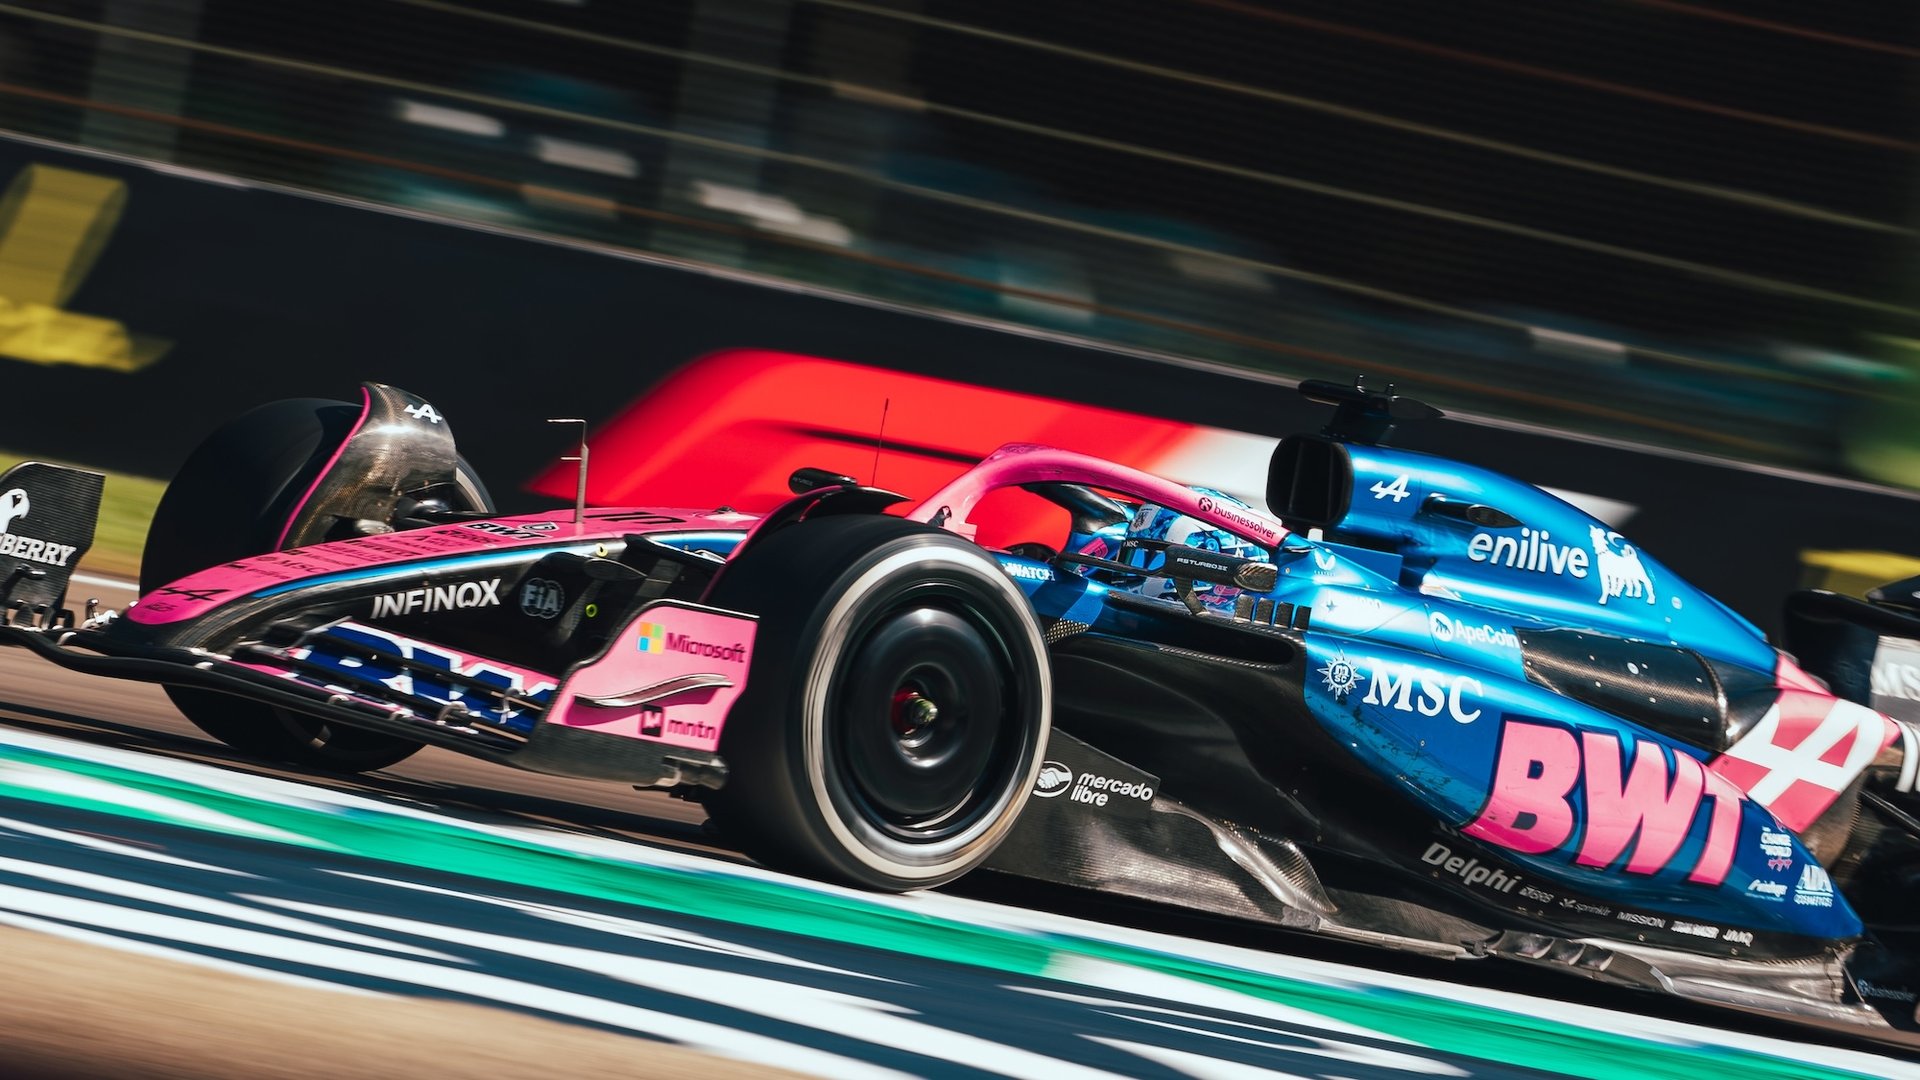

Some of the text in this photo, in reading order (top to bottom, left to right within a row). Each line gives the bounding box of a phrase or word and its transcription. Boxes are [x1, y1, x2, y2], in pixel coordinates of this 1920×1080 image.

[1213, 502, 1277, 540] businessolver
[0, 533, 77, 567] BERRY
[1467, 527, 1589, 578] enilive
[370, 578, 501, 620] INFINOX
[665, 632, 746, 663] Microsoft
[1455, 619, 1520, 649] ApeCoin
[1362, 656, 1483, 724] MSC
[667, 719, 716, 740] mntn
[1070, 784, 1109, 807] libre
[1077, 772, 1153, 801] mercado
[1459, 720, 1747, 887] BWT
[1421, 841, 1522, 895] Delphi
[1617, 911, 1666, 929] MISSION
